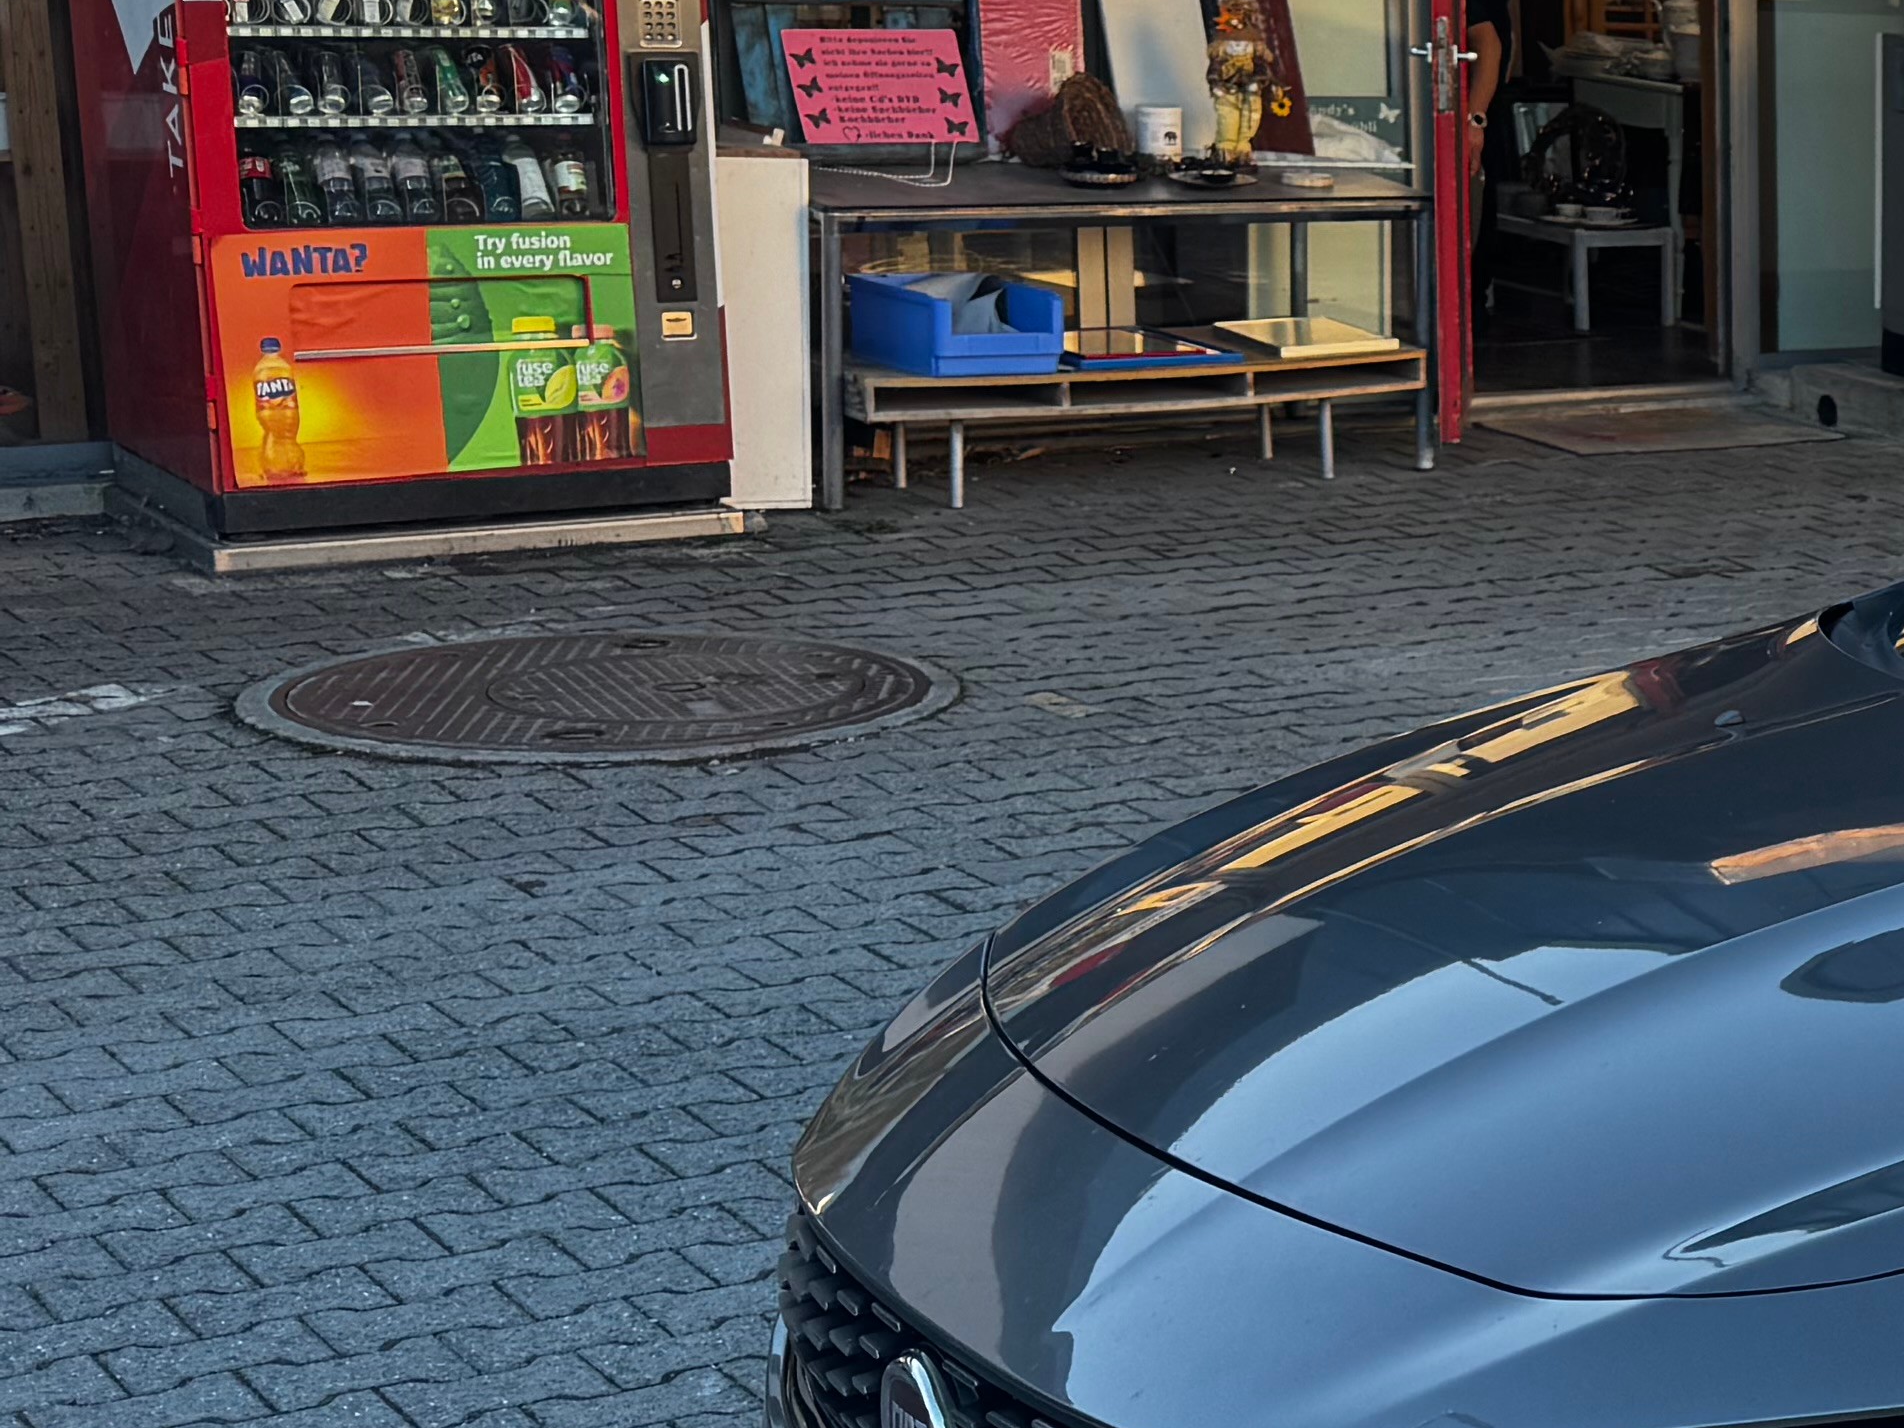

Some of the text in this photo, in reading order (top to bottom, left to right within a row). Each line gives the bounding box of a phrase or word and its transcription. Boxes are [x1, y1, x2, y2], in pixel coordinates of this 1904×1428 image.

[157, 8, 184, 179] TAKE
[474, 231, 572, 253] Try fusion
[241, 243, 368, 278] WANTA?
[477, 250, 614, 272] in every flavor
[516, 358, 554, 374] fuse
